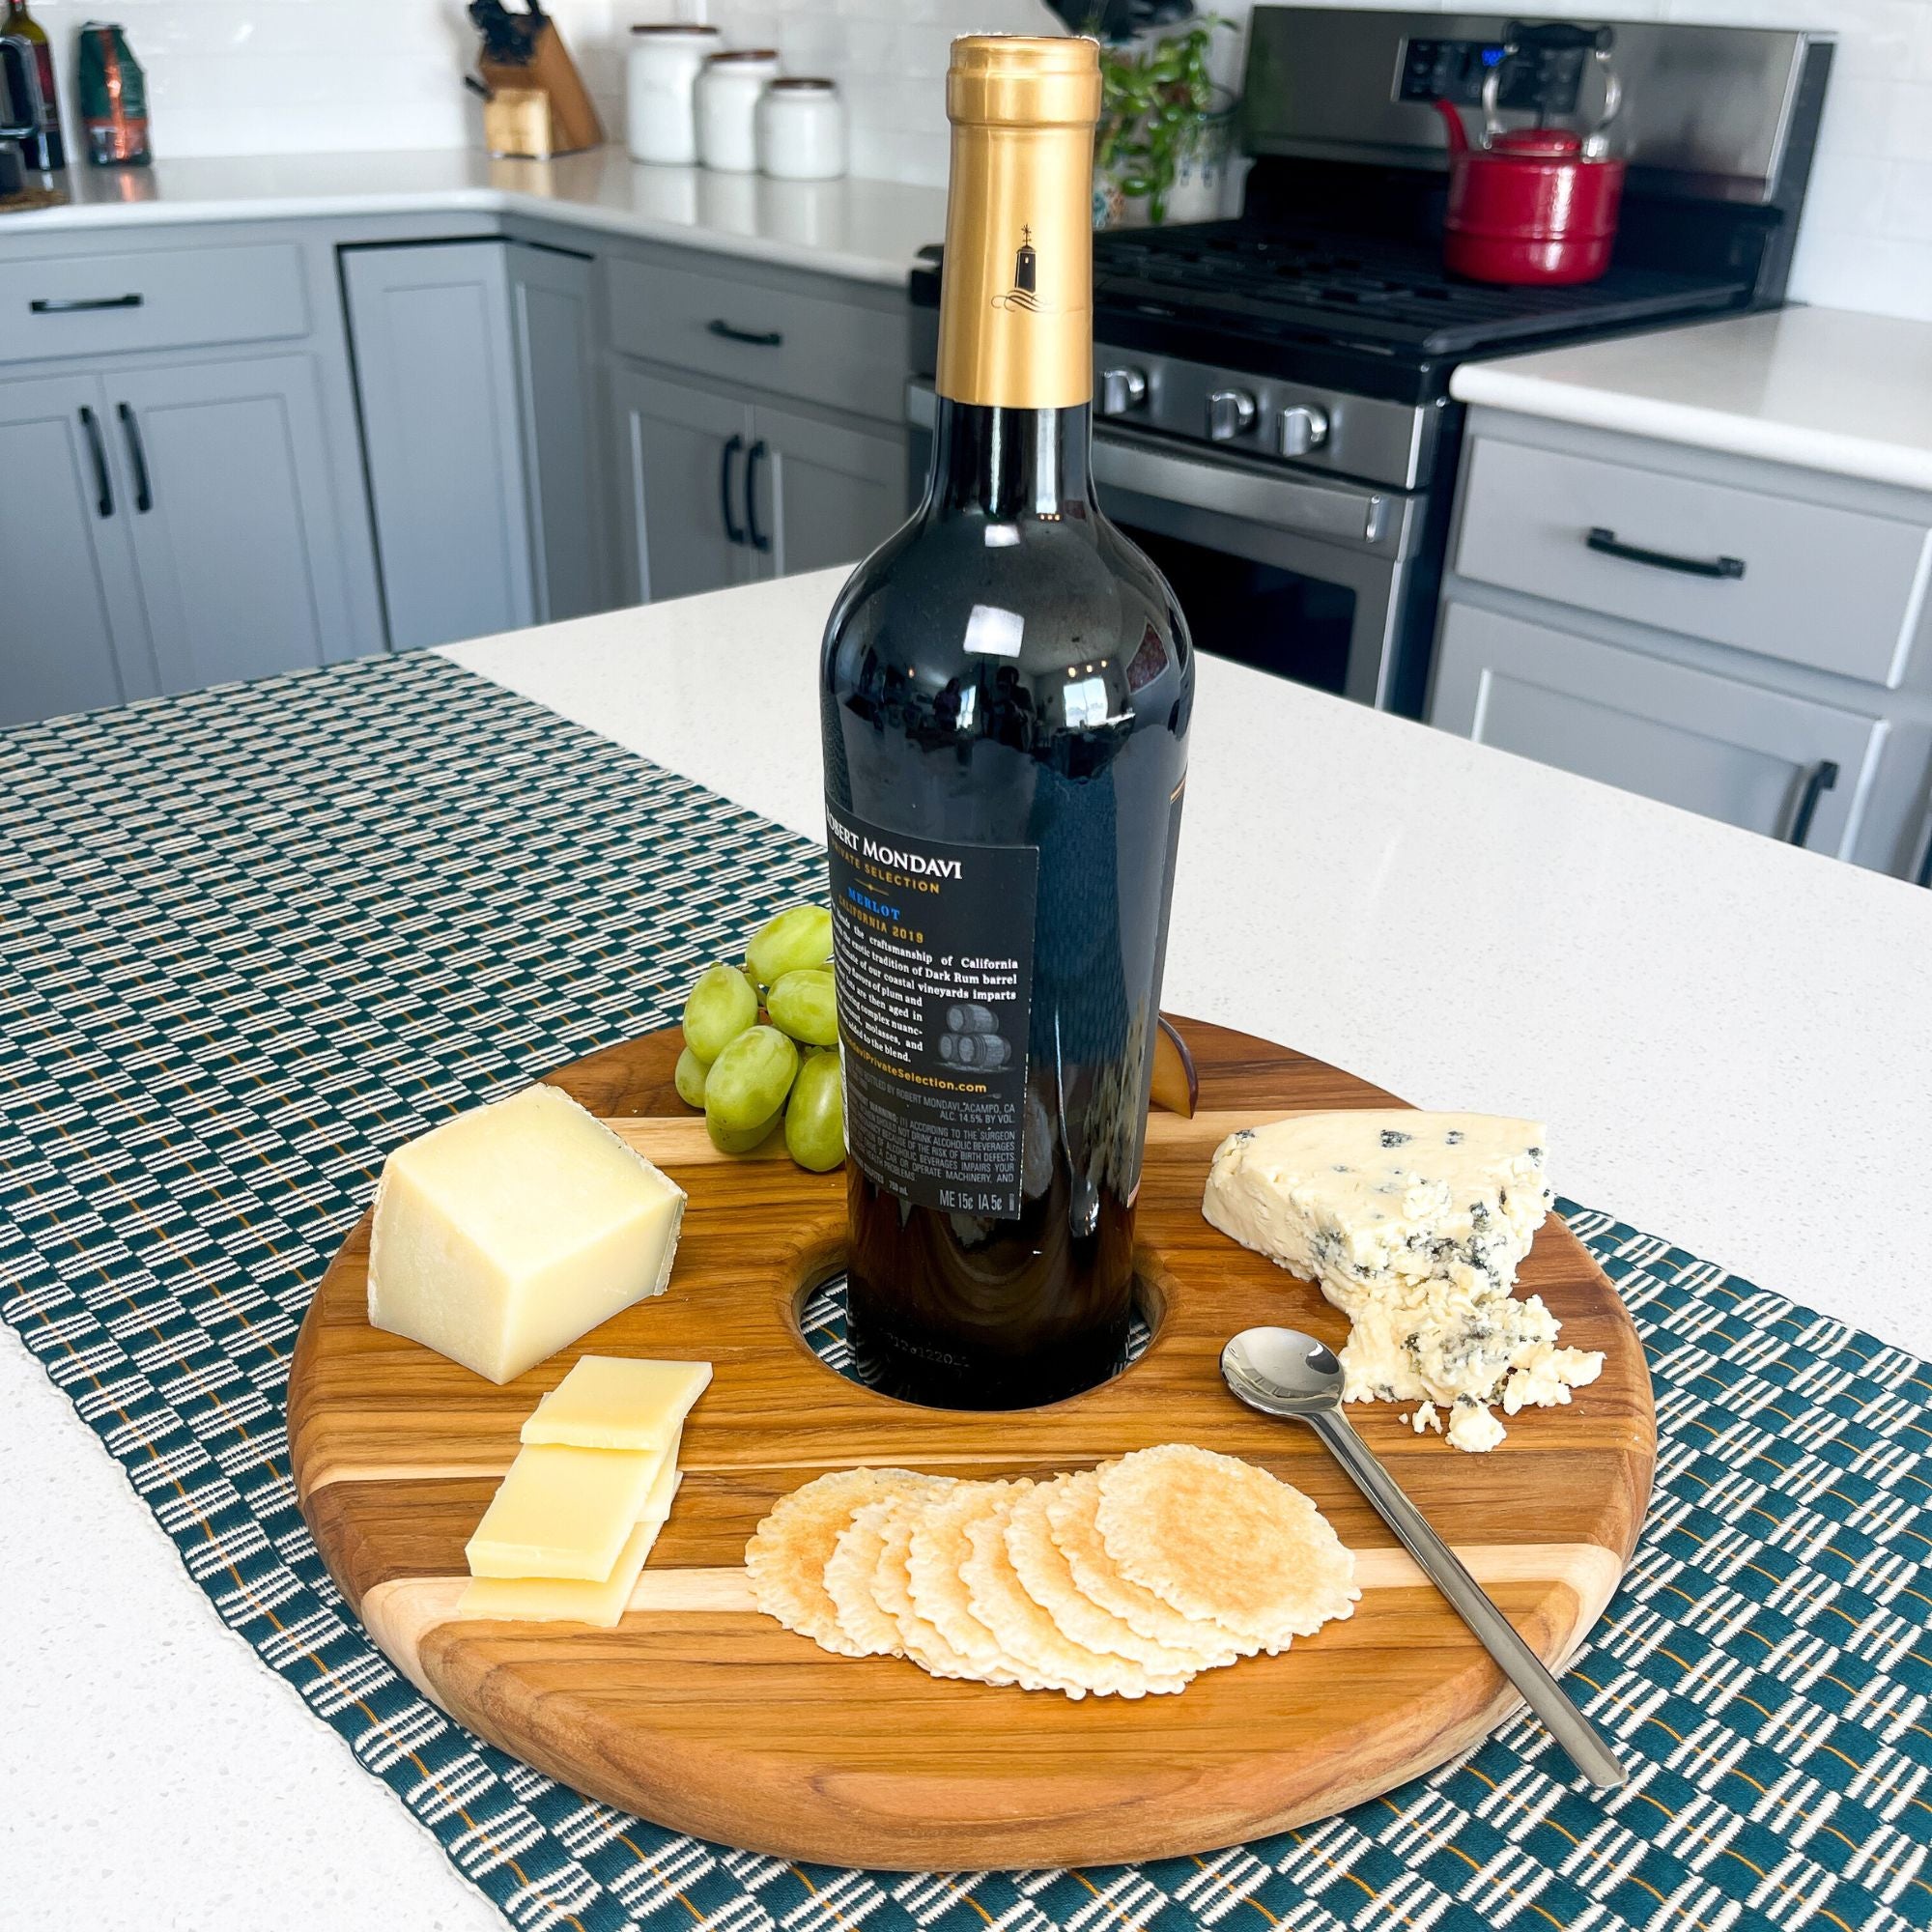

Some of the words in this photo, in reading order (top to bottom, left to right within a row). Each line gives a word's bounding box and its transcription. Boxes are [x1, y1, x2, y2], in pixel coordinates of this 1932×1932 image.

[863, 837, 963, 880] MONDAVI
[865, 863, 941, 895] SELECTION
[847, 887, 900, 921] MERLOT
[838, 895, 888, 933] CALIFORNIA
[893, 925, 923, 944] 2019
[854, 924, 865, 939] the
[869, 936, 933, 965] craftsmanship
[941, 955, 953, 966] of
[960, 956, 1018, 970] California
[860, 960, 867, 970] of
[868, 966, 882, 979] our
[883, 972, 915, 990] coastal
[918, 981, 969, 1000] vineyards
[973, 988, 1016, 1002] imparts
[871, 951, 910, 974] tradition
[912, 966, 923, 977] of
[924, 968, 951, 981] Dark
[953, 972, 980, 984] Rum
[982, 973, 1017, 985] barrel
[868, 993, 886, 1010] then
[889, 1005, 909, 1019] aged
[912, 1009, 923, 1022] in
[872, 981, 881, 993] of
[881, 986, 903, 1002] plum
[904, 995, 923, 1008] and
[861, 1005, 890, 1027] complex
[892, 1020, 923, 1036] nuanc-
[864, 1033, 871, 1044] to
[871, 1038, 884, 1052] the
[884, 1043, 912, 1064] blend.
[865, 1021, 901, 1045] molasses,
[905, 1039, 923, 1052] and
[895, 1088, 922, 1104] ROBERT
[1004, 1103, 1015, 1114] CA
[909, 1121, 948, 1138] ACCORDING
[951, 1128, 960, 1139] TO
[963, 1129, 978, 1140] THE
[980, 1130, 1015, 1141] SURGEON
[984, 1114, 995, 1123] BY
[911, 1130, 931, 1145] DRINK
[933, 1136, 972, 1151] ALCOHOLIC
[973, 1141, 1015, 1151] BEVERAGES
[918, 1143, 930, 1155] THE
[931, 1146, 948, 1157] RISK
[950, 1150, 959, 1159] OF
[960, 1151, 981, 1161] BIRTH
[983, 1152, 1014, 1162] DEFECTS
[961, 1161, 991, 1172] IMPAIRS
[994, 1162, 1014, 1173] YOUR
[996, 1173, 1014, 1182] AND
[939, 1189, 955, 1208] ME
[979, 1193, 990, 1210] IA
